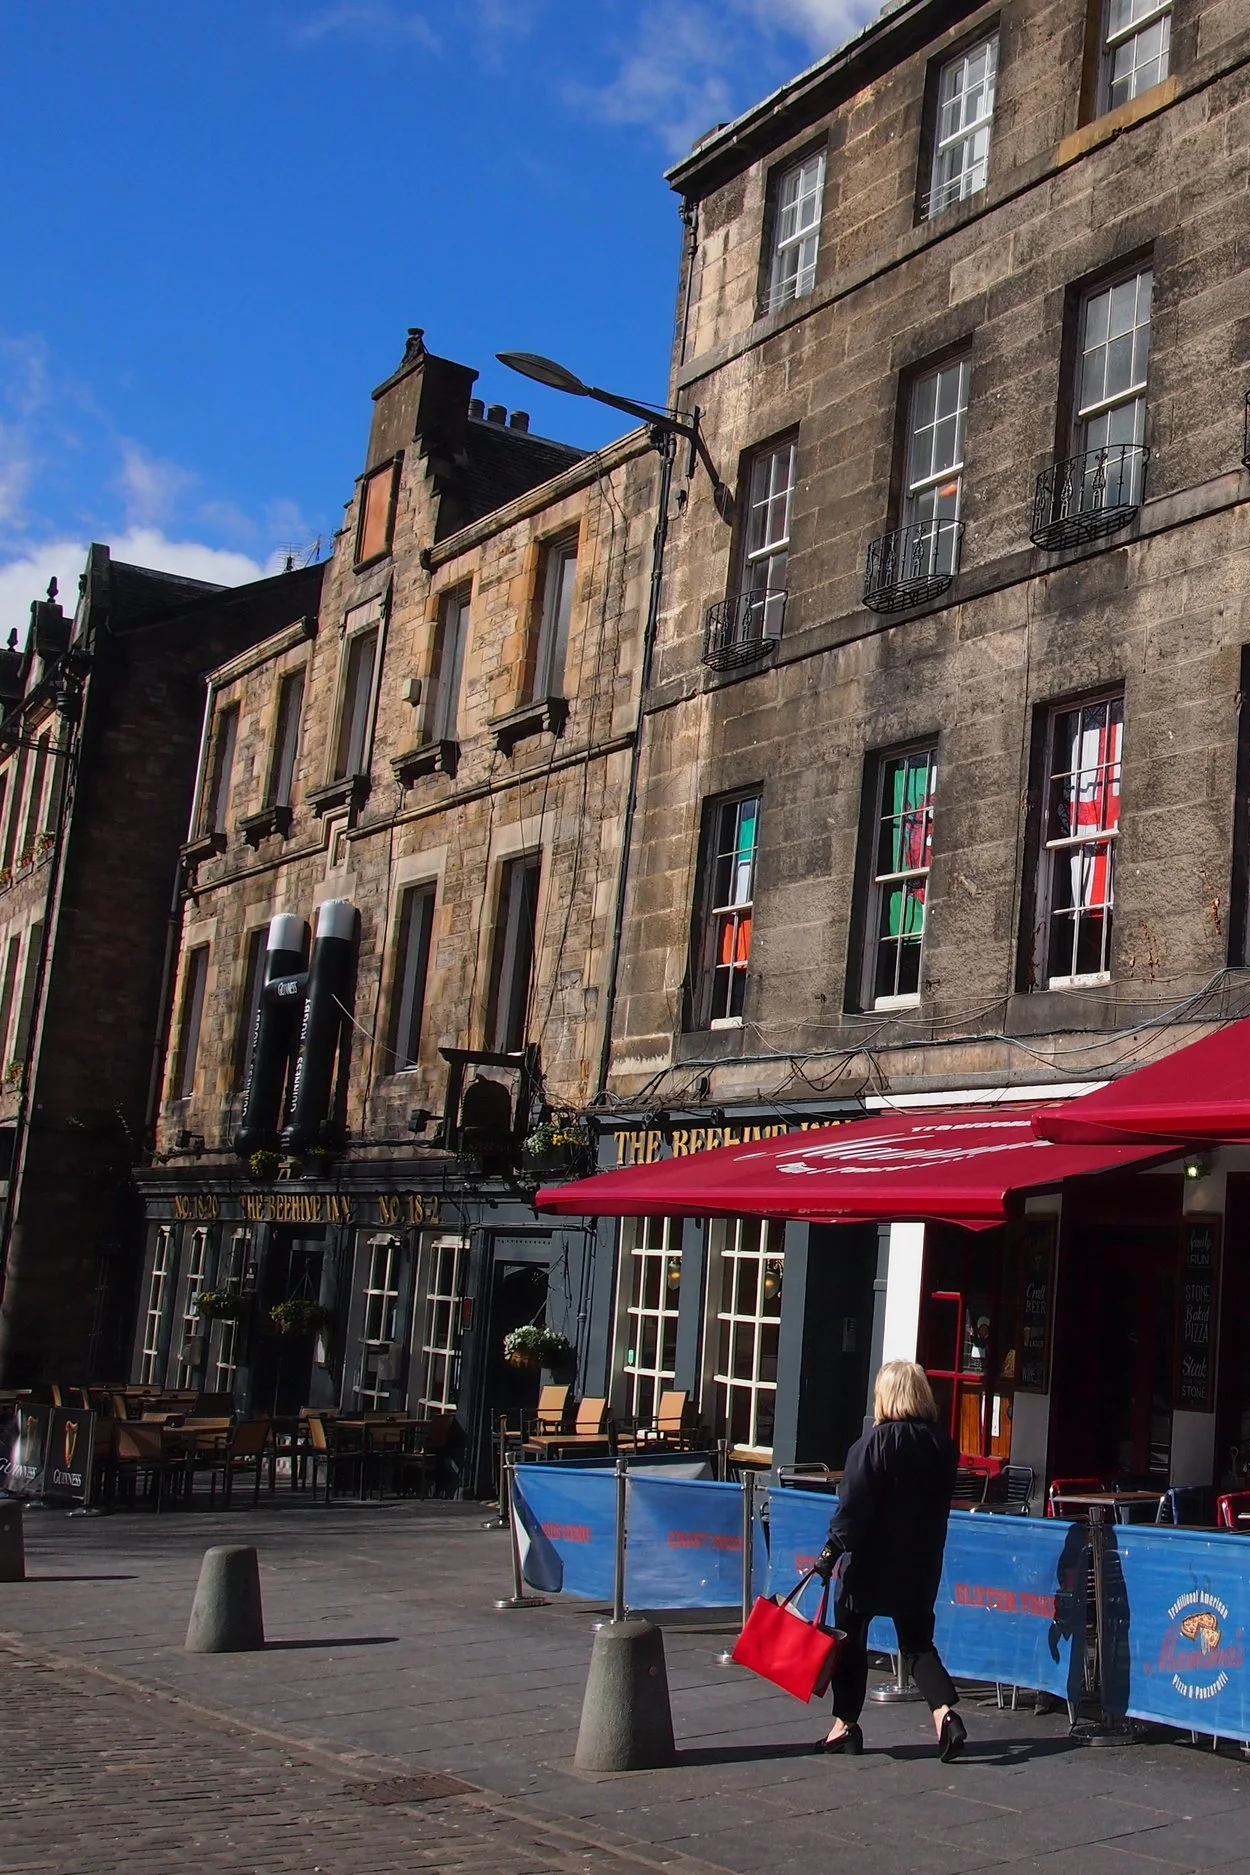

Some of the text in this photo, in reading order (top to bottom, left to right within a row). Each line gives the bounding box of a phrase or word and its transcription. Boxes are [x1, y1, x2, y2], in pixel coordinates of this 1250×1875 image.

[300, 998, 312, 1040] RUGBY
[614, 1130, 662, 1165] THE
[268, 1194, 322, 1221] BEEHIVE
[1190, 1254, 1209, 1265] RUN
[1185, 1285, 1211, 1302] STONE
[1025, 1301, 1046, 1314] BEER
[1185, 1322, 1209, 1343] PIZZA
[1181, 1385, 1207, 1399] STONE
[53, 1468, 82, 1487] GUINNESS
[667, 1530, 710, 1549] CRAFT
[954, 1583, 1018, 1613] GLUTEN
[1168, 1589, 1229, 1620] Traditional American
